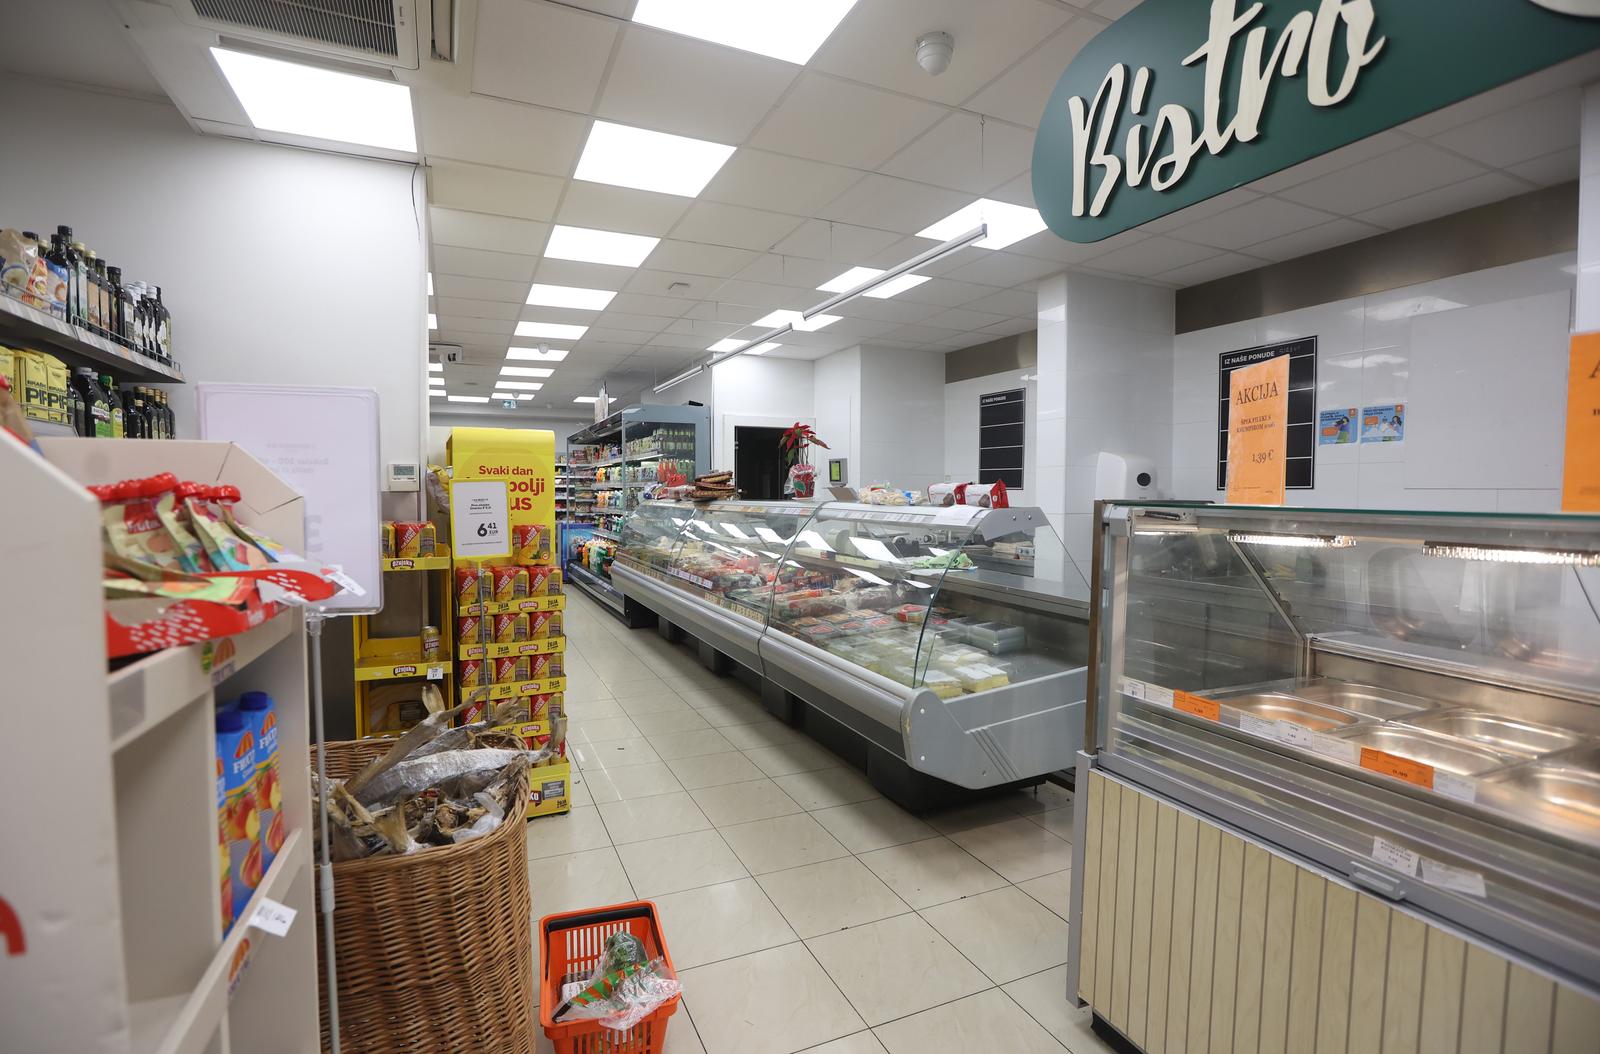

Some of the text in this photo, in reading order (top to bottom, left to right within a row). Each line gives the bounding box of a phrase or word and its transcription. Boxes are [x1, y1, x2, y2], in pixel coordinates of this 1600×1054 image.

[1067, 0, 1390, 218] Bistro
[1231, 354, 1248, 364] NAŠE
[1248, 350, 1275, 362] PONUDE
[1235, 380, 1279, 406] AKCIJA
[1267, 449, 1275, 461] €
[478, 465, 534, 476] Svaki dan
[477, 523, 488, 538] 6
